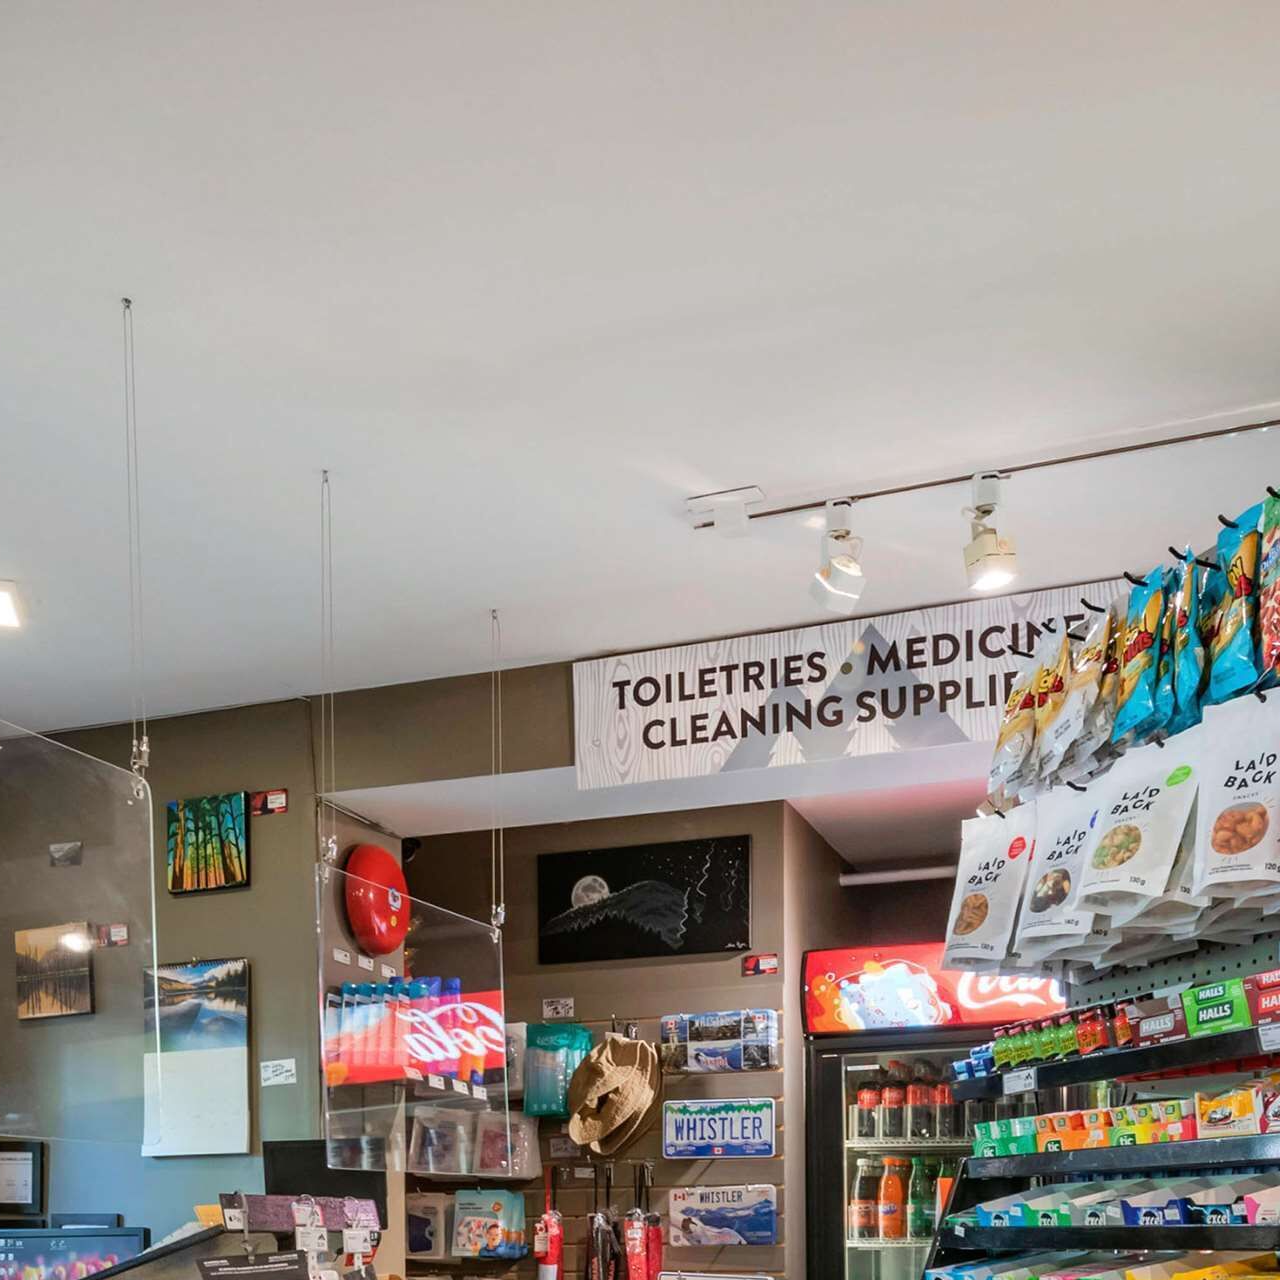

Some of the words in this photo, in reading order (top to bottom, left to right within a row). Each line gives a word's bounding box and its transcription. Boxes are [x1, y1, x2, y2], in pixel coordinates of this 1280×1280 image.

[612, 650, 828, 709] TOILETRIES
[642, 696, 844, 750] CLEANING
[856, 672, 1018, 724] SUPPLIE
[1122, 786, 1160, 803] LAID
[1111, 798, 1155, 816] BACK
[1056, 830, 1087, 847] LAID
[978, 858, 1005, 872] LAID
[968, 870, 1002, 886] BACK
[1199, 985, 1224, 999] HALLS
[1198, 1003, 1231, 1021] HALLS
[1142, 1017, 1172, 1032] HALLS
[675, 1117, 763, 1141] WHISTLER
[699, 1190, 743, 1204] WHISTLER
